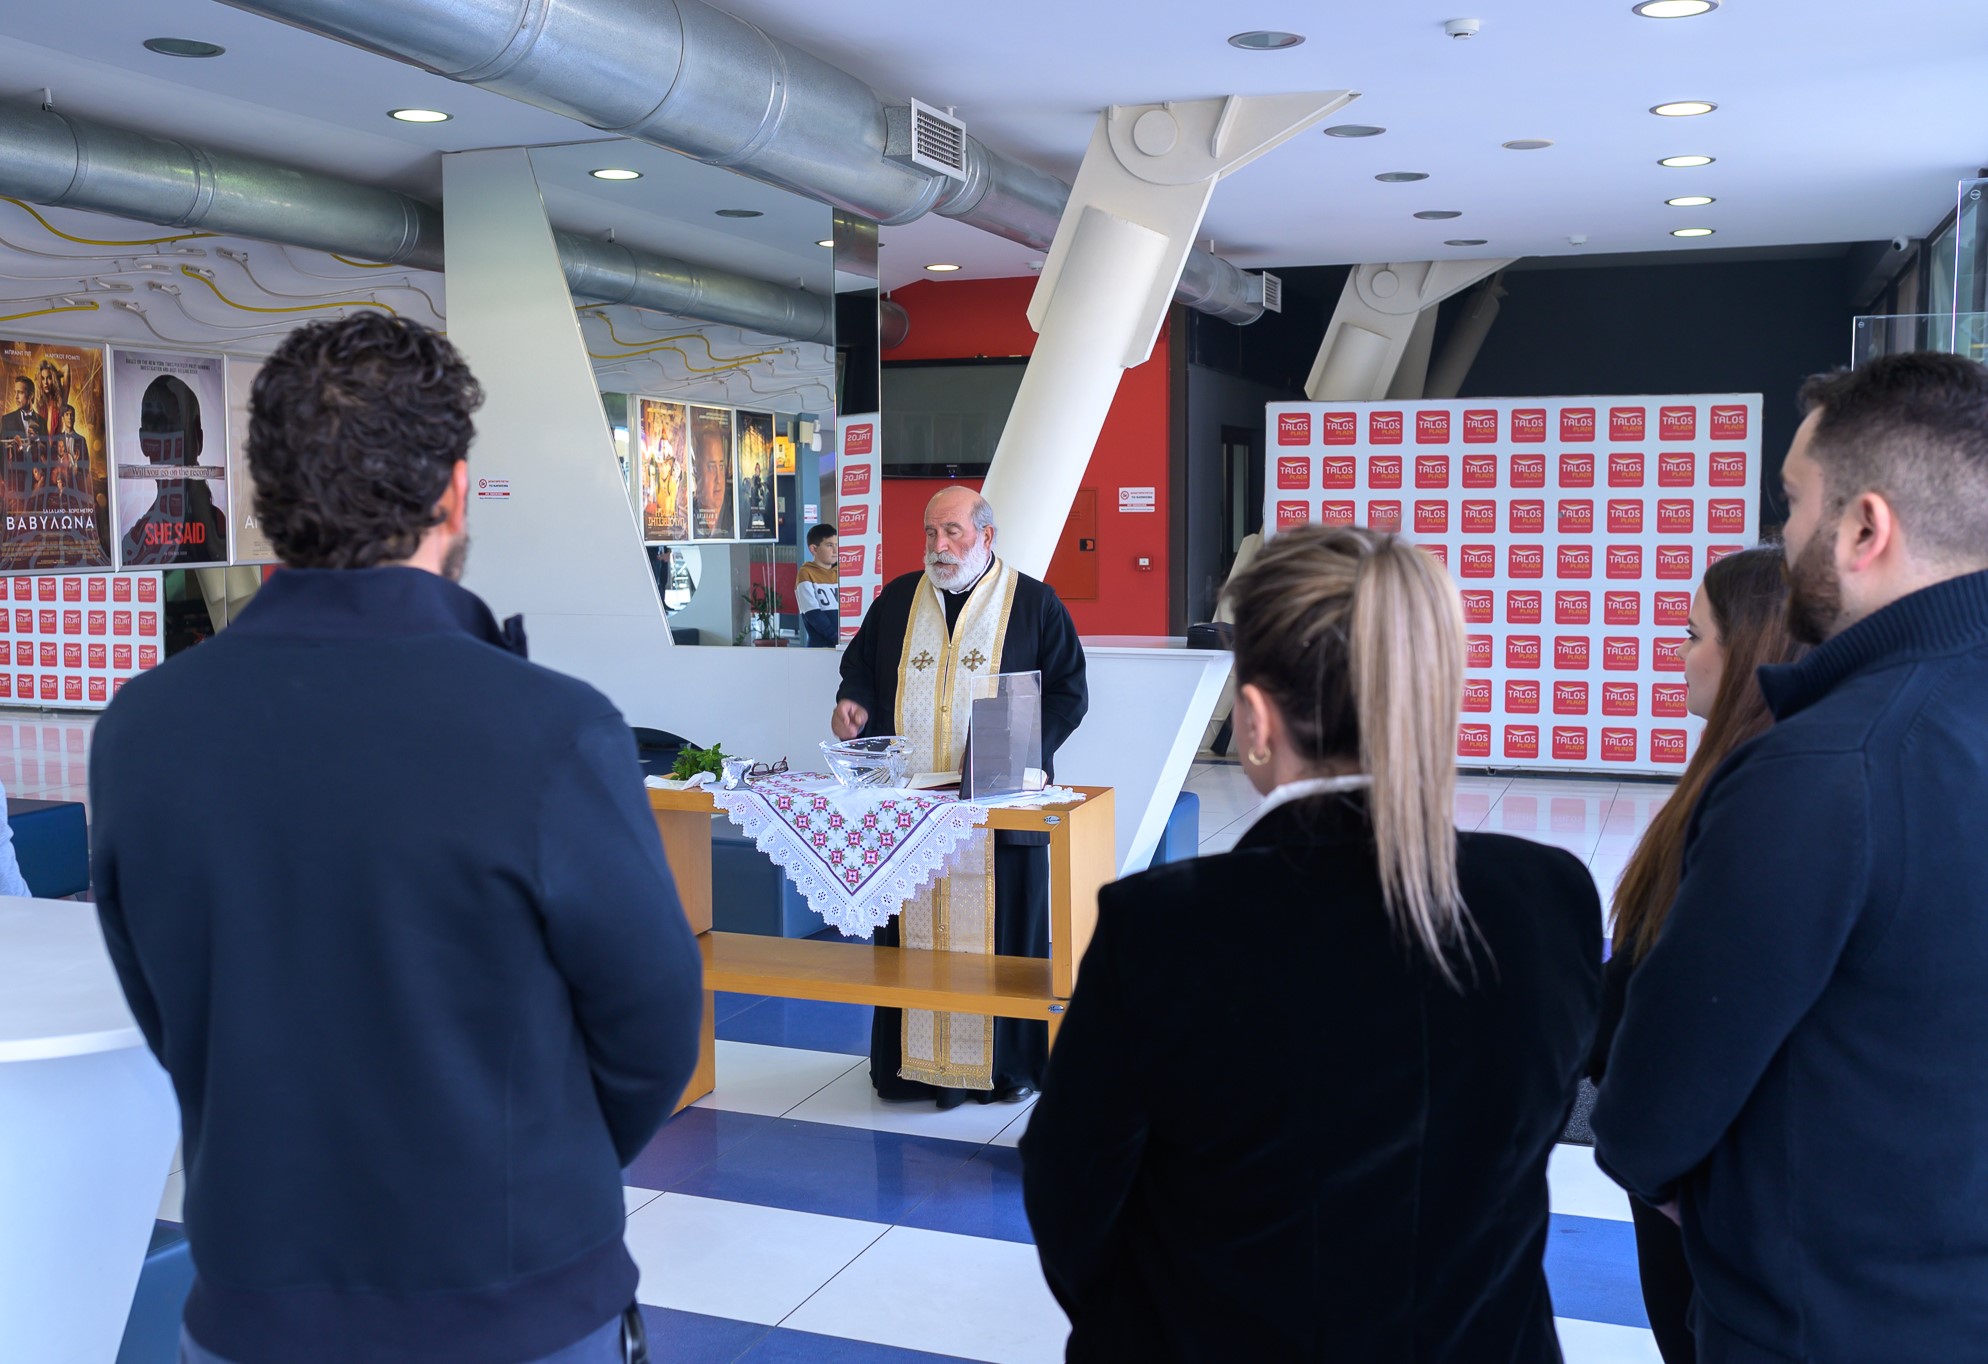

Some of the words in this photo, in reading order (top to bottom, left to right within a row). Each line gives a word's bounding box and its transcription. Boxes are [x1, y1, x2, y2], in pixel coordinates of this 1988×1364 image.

[1713, 415, 1744, 424] TALOS
[1661, 463, 1691, 471] TALOS
[1712, 462, 1743, 470] TALOS
[1660, 509, 1690, 517] TALOS
[1711, 509, 1741, 517] TALOS
[6, 516, 94, 530] ΒΑΒΥΛΩΝΑ
[144, 522, 172, 545] SHE
[174, 522, 206, 545] SAID
[1609, 555, 1639, 563] TALOS
